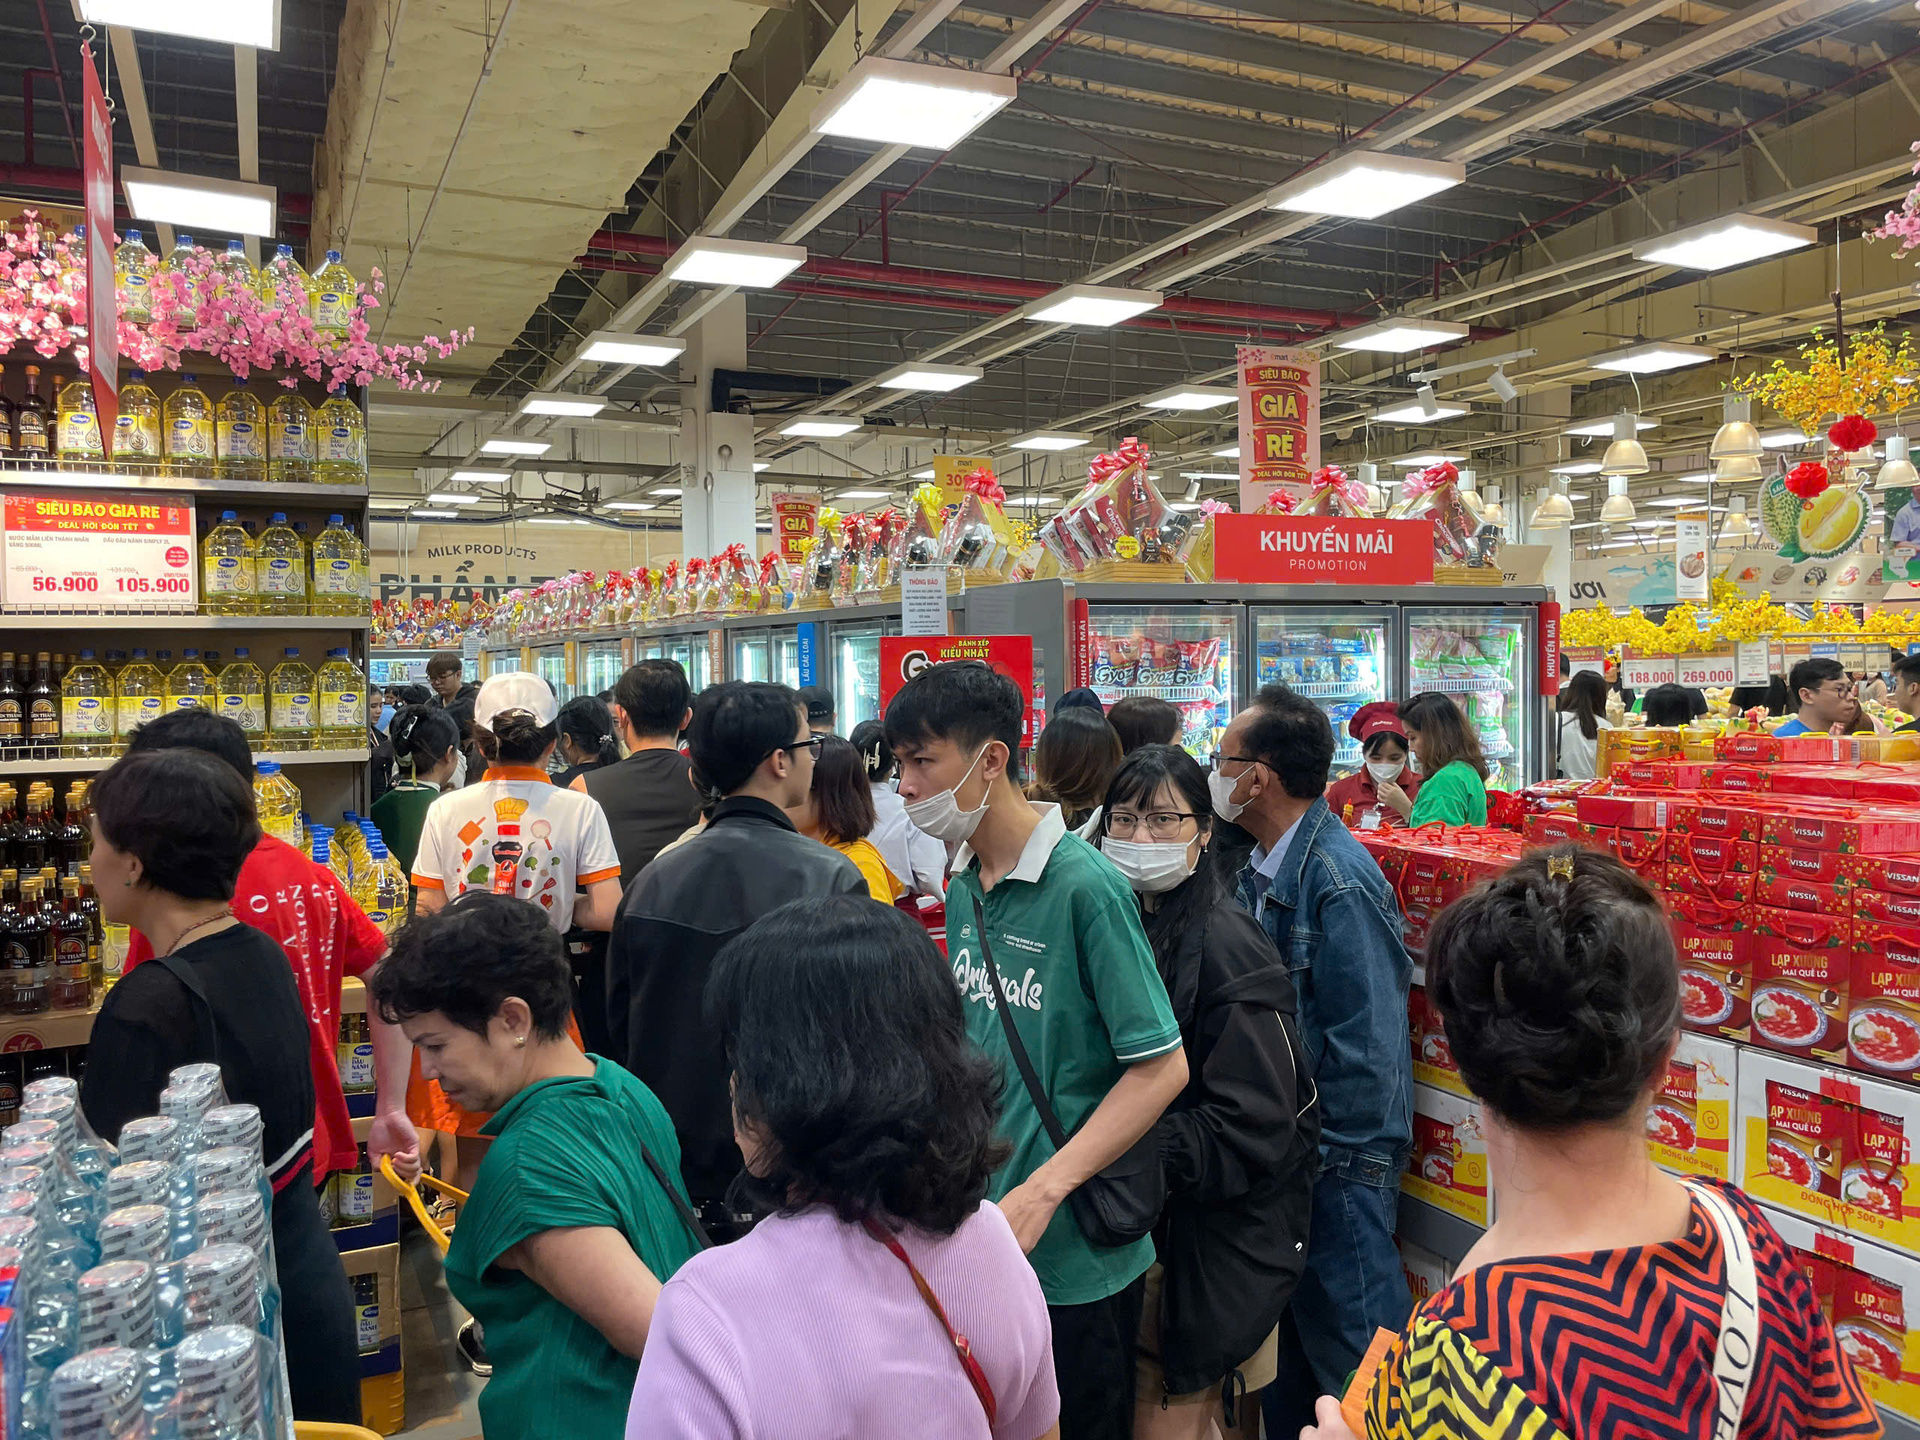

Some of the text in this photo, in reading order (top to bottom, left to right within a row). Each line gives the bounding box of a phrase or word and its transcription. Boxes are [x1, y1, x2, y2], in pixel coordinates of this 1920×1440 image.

[1259, 393, 1300, 419] GIÁ
[1266, 430, 1295, 459] RẺ
[35, 500, 70, 516] SIÊU
[58, 521, 80, 529] DEAL
[1260, 525, 1393, 554] KHUYẾN MÃI
[427, 544, 462, 559] MILK
[1289, 558, 1367, 571] PROMOTION
[32, 576, 99, 592] 56.900
[115, 577, 190, 593] 105.900
[1545, 619, 1556, 678] KHUYẾN MÃI
[1097, 664, 1135, 685] Gyoz
[1137, 667, 1175, 685] Gyoz
[1629, 671, 1674, 684] 188.000
[1683, 670, 1734, 683] 269.000
[1700, 816, 1727, 826] VISSAN
[1793, 827, 1825, 838] VISSAN
[1693, 847, 1720, 857] VISSAN
[1790, 858, 1820, 869] VISSAN
[1886, 871, 1920, 883] VISSAN
[1692, 951, 1706, 959] MAI
[1782, 968, 1797, 976] MAI
[1883, 988, 1899, 996] MAI
[1778, 1086, 1809, 1101] VISSAN
[1769, 1105, 1785, 1120] ẠP
[1775, 1120, 1790, 1128] MAI
[1875, 1150, 1892, 1159] MAI
[1856, 1210, 1877, 1223] 500
[1878, 1219, 1885, 1230] g
